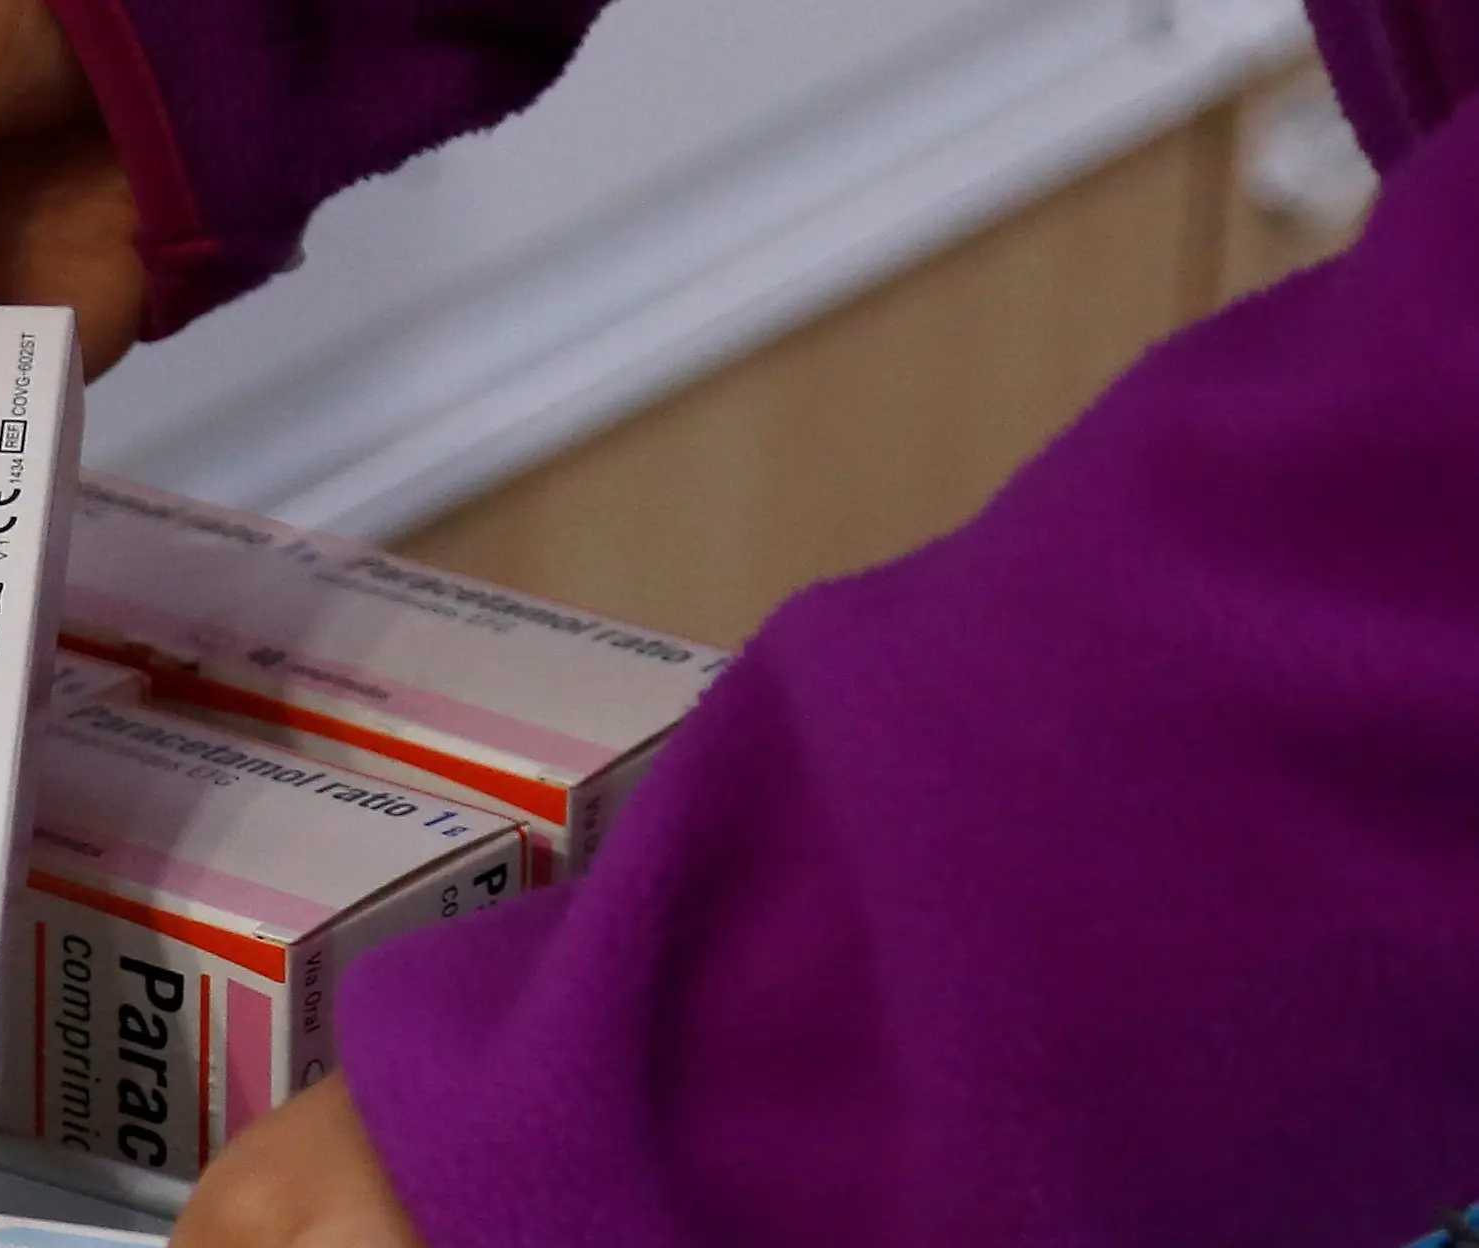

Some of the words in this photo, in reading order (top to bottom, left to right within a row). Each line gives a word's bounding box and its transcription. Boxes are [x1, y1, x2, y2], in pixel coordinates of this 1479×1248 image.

[12, 332, 36, 416] COVG-602ST
[9, 458, 24, 483] 1434
[67, 703, 323, 789] Paracetamol
[314, 776, 419, 819] ratio
